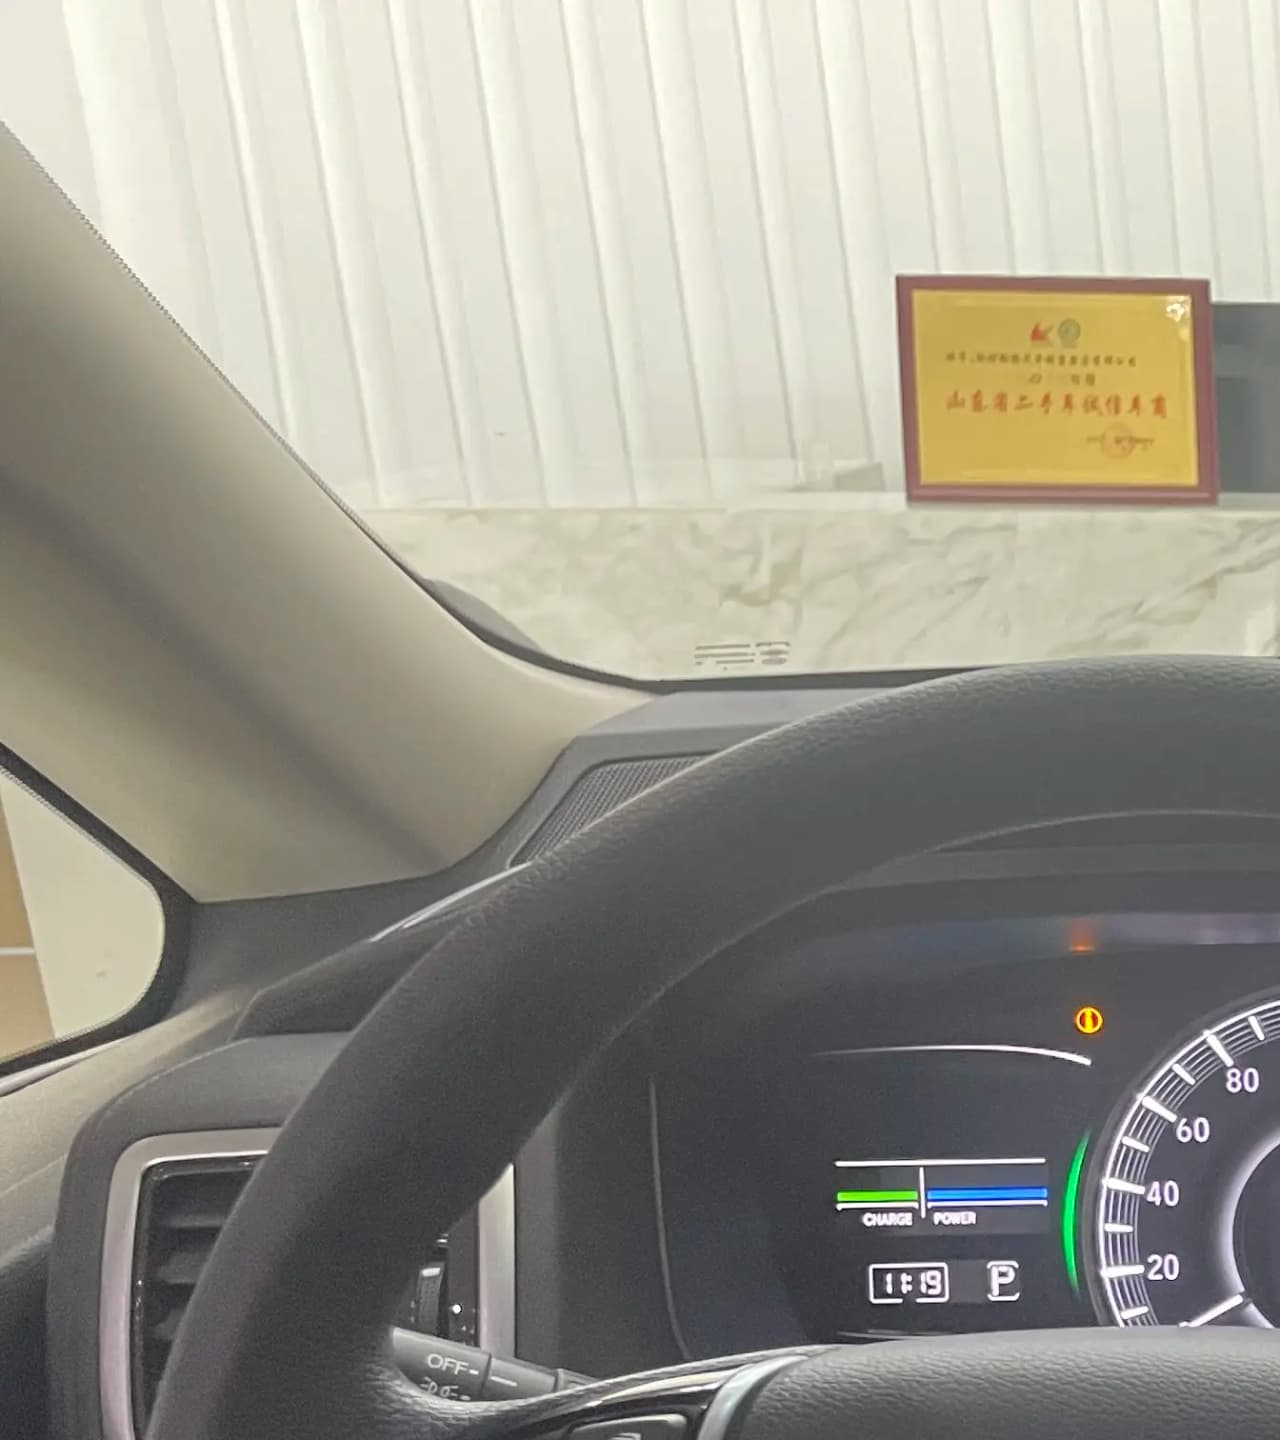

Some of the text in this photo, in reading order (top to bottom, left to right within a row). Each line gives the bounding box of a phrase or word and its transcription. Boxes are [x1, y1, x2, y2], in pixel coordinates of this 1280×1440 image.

[1225, 1068, 1260, 1093] 80
[1175, 1117, 1211, 1143] 60
[1146, 1180, 1180, 1206] 40
[862, 1212, 913, 1226] CHARGE
[933, 1211, 977, 1225] POWER
[1147, 1254, 1180, 1281] 20
[991, 1266, 1016, 1296] P
[427, 1353, 469, 1375] OFF
